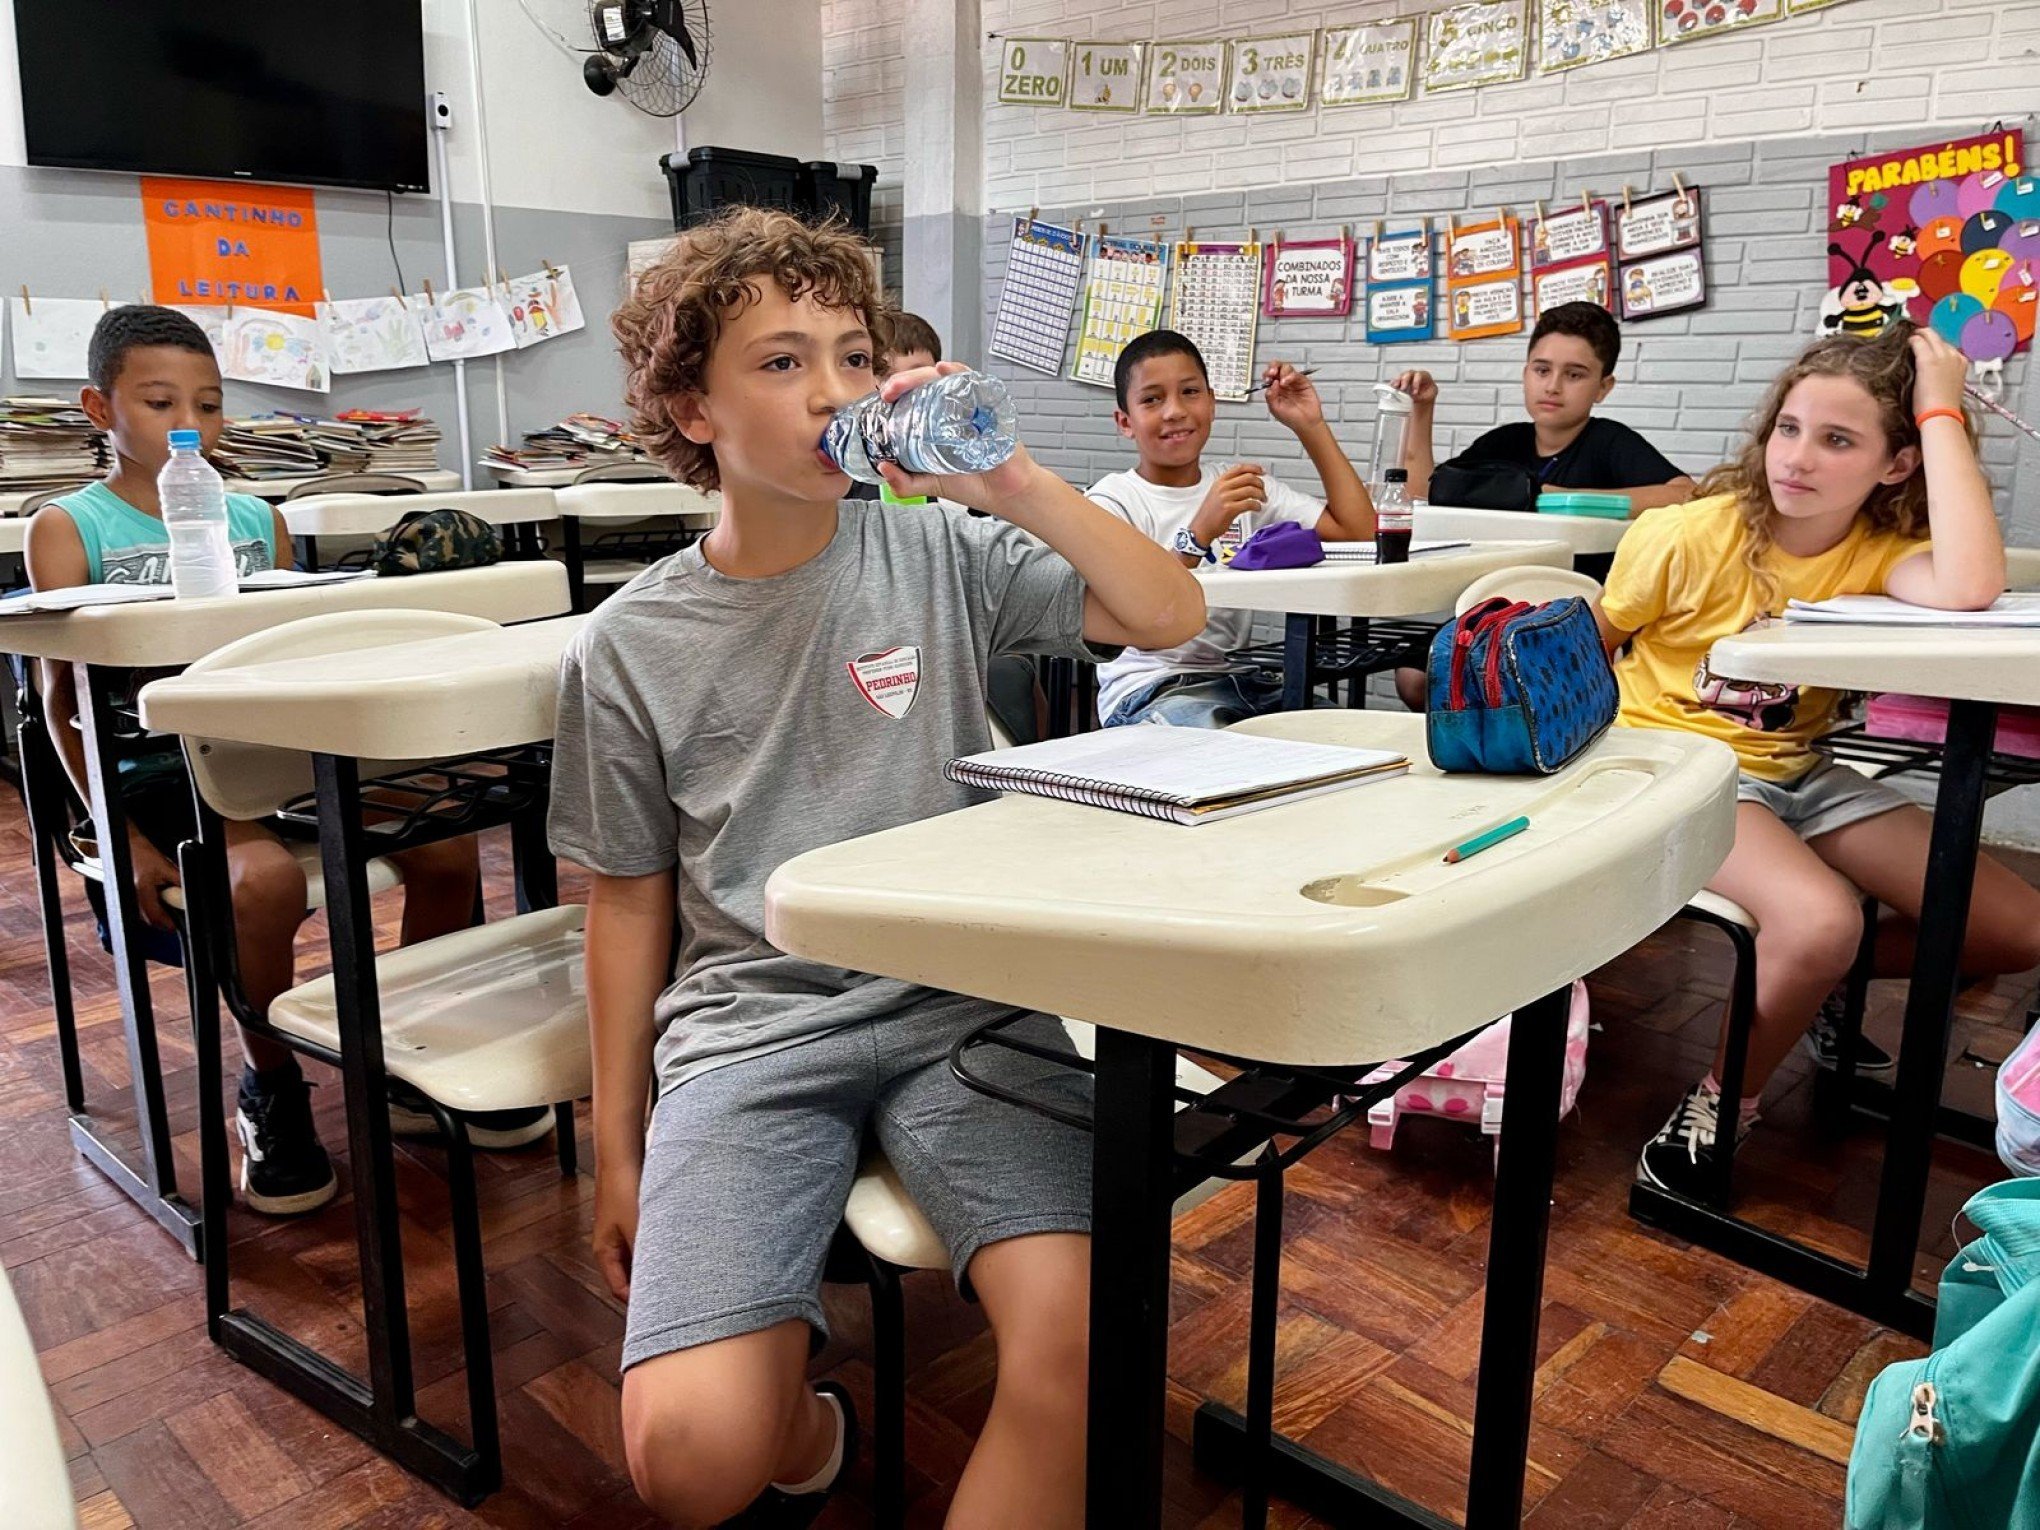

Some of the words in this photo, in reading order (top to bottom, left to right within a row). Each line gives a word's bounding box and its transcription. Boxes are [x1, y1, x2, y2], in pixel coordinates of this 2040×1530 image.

[1081, 51, 1092, 76] 1
[1101, 58, 1128, 76] UM
[1159, 51, 1177, 77] 2
[1181, 56, 1216, 71] DOIS
[1242, 48, 1258, 75] 3
[1263, 51, 1305, 71] TRÊS
[1004, 74, 1059, 96] ZERO
[1846, 135, 2020, 196] PARABÉNS!
[217, 237, 250, 257] DA
[1277, 260, 1341, 272] COMBINADOS
[1286, 273, 1298, 284] DA
[1301, 273, 1330, 284] NOSSA
[179, 281, 301, 301] LEITURA
[1292, 286, 1323, 297] TURMA
[866, 671, 917, 692] PEDRINHO
